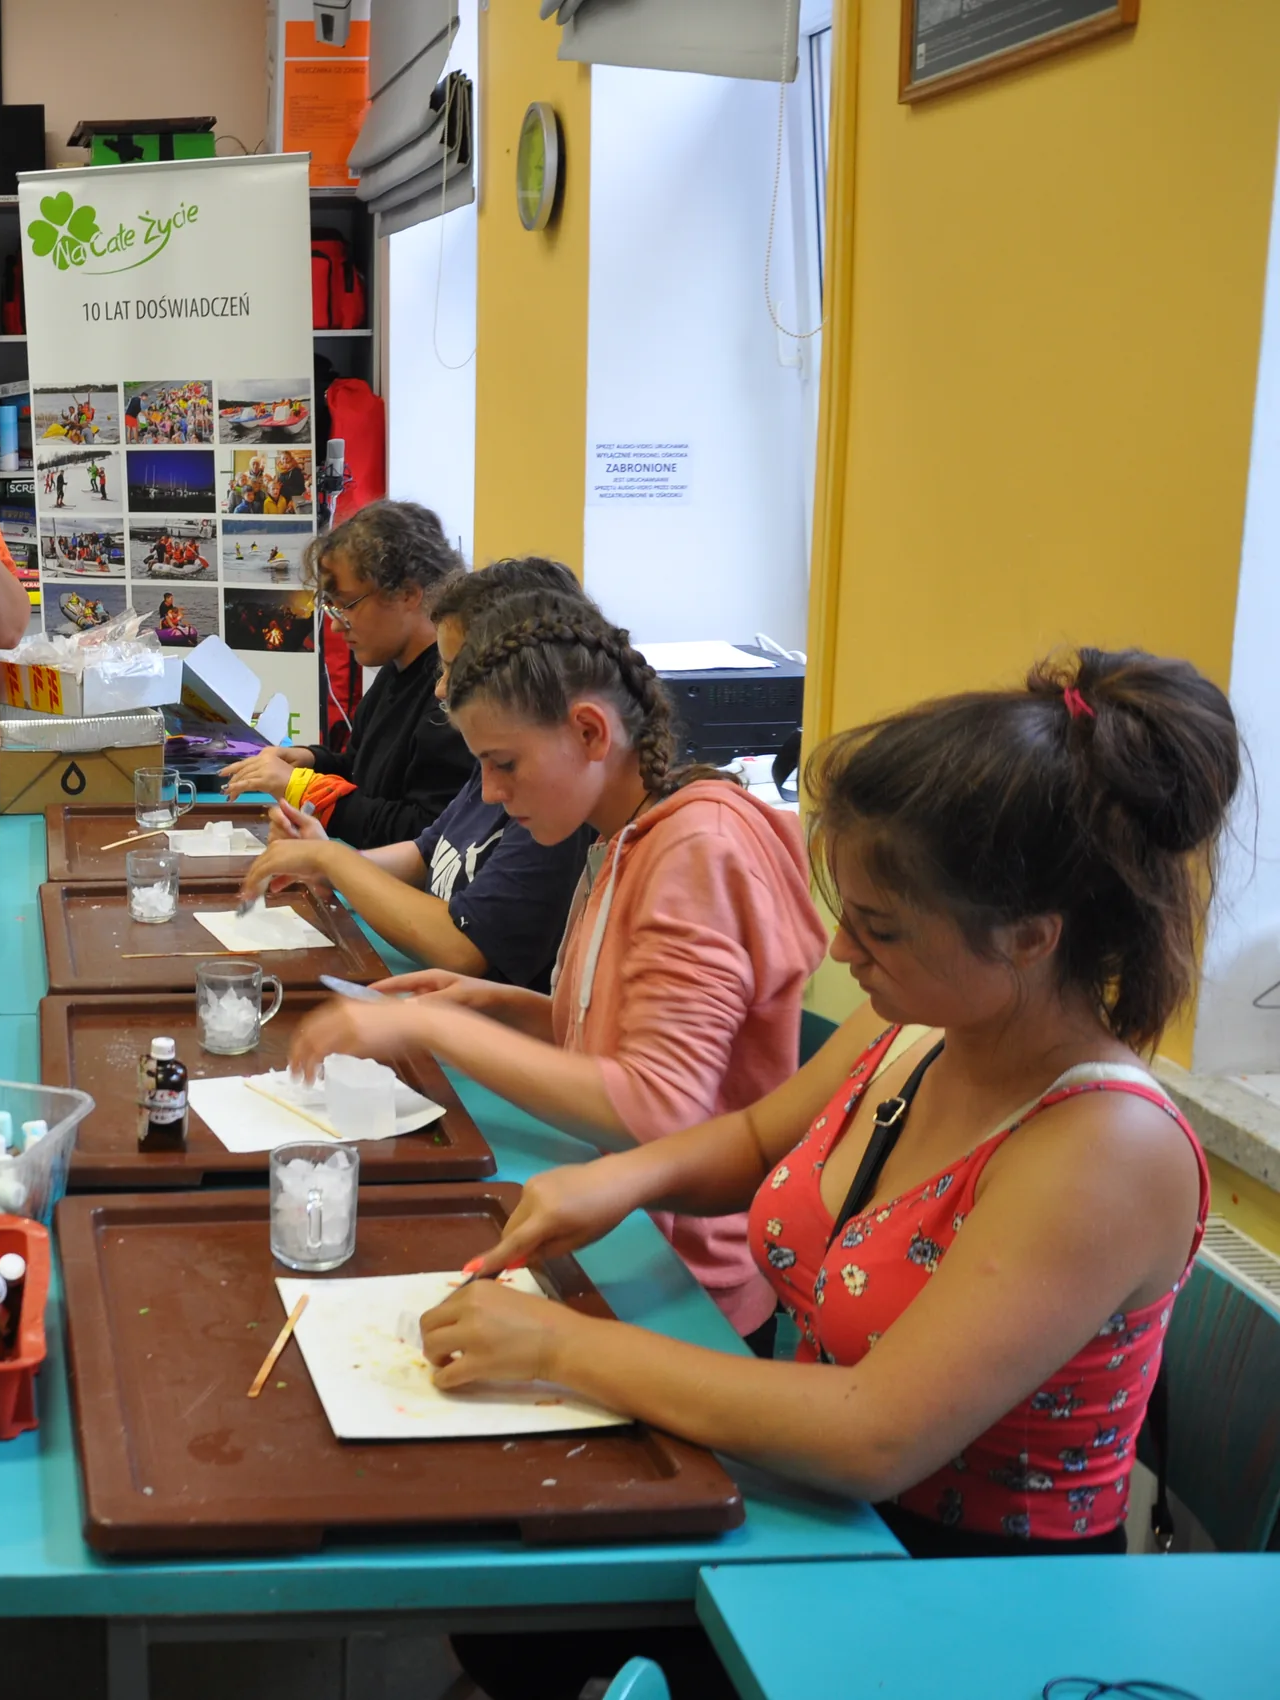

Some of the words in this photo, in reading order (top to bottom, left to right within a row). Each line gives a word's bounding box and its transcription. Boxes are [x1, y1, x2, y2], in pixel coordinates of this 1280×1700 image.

[54, 238, 88, 269] Na
[82, 302, 101, 322] 10
[105, 300, 131, 321] LAT
[136, 291, 250, 320] DOŚWIADCZEŃ
[605, 463, 677, 473] ZABRONIONE
